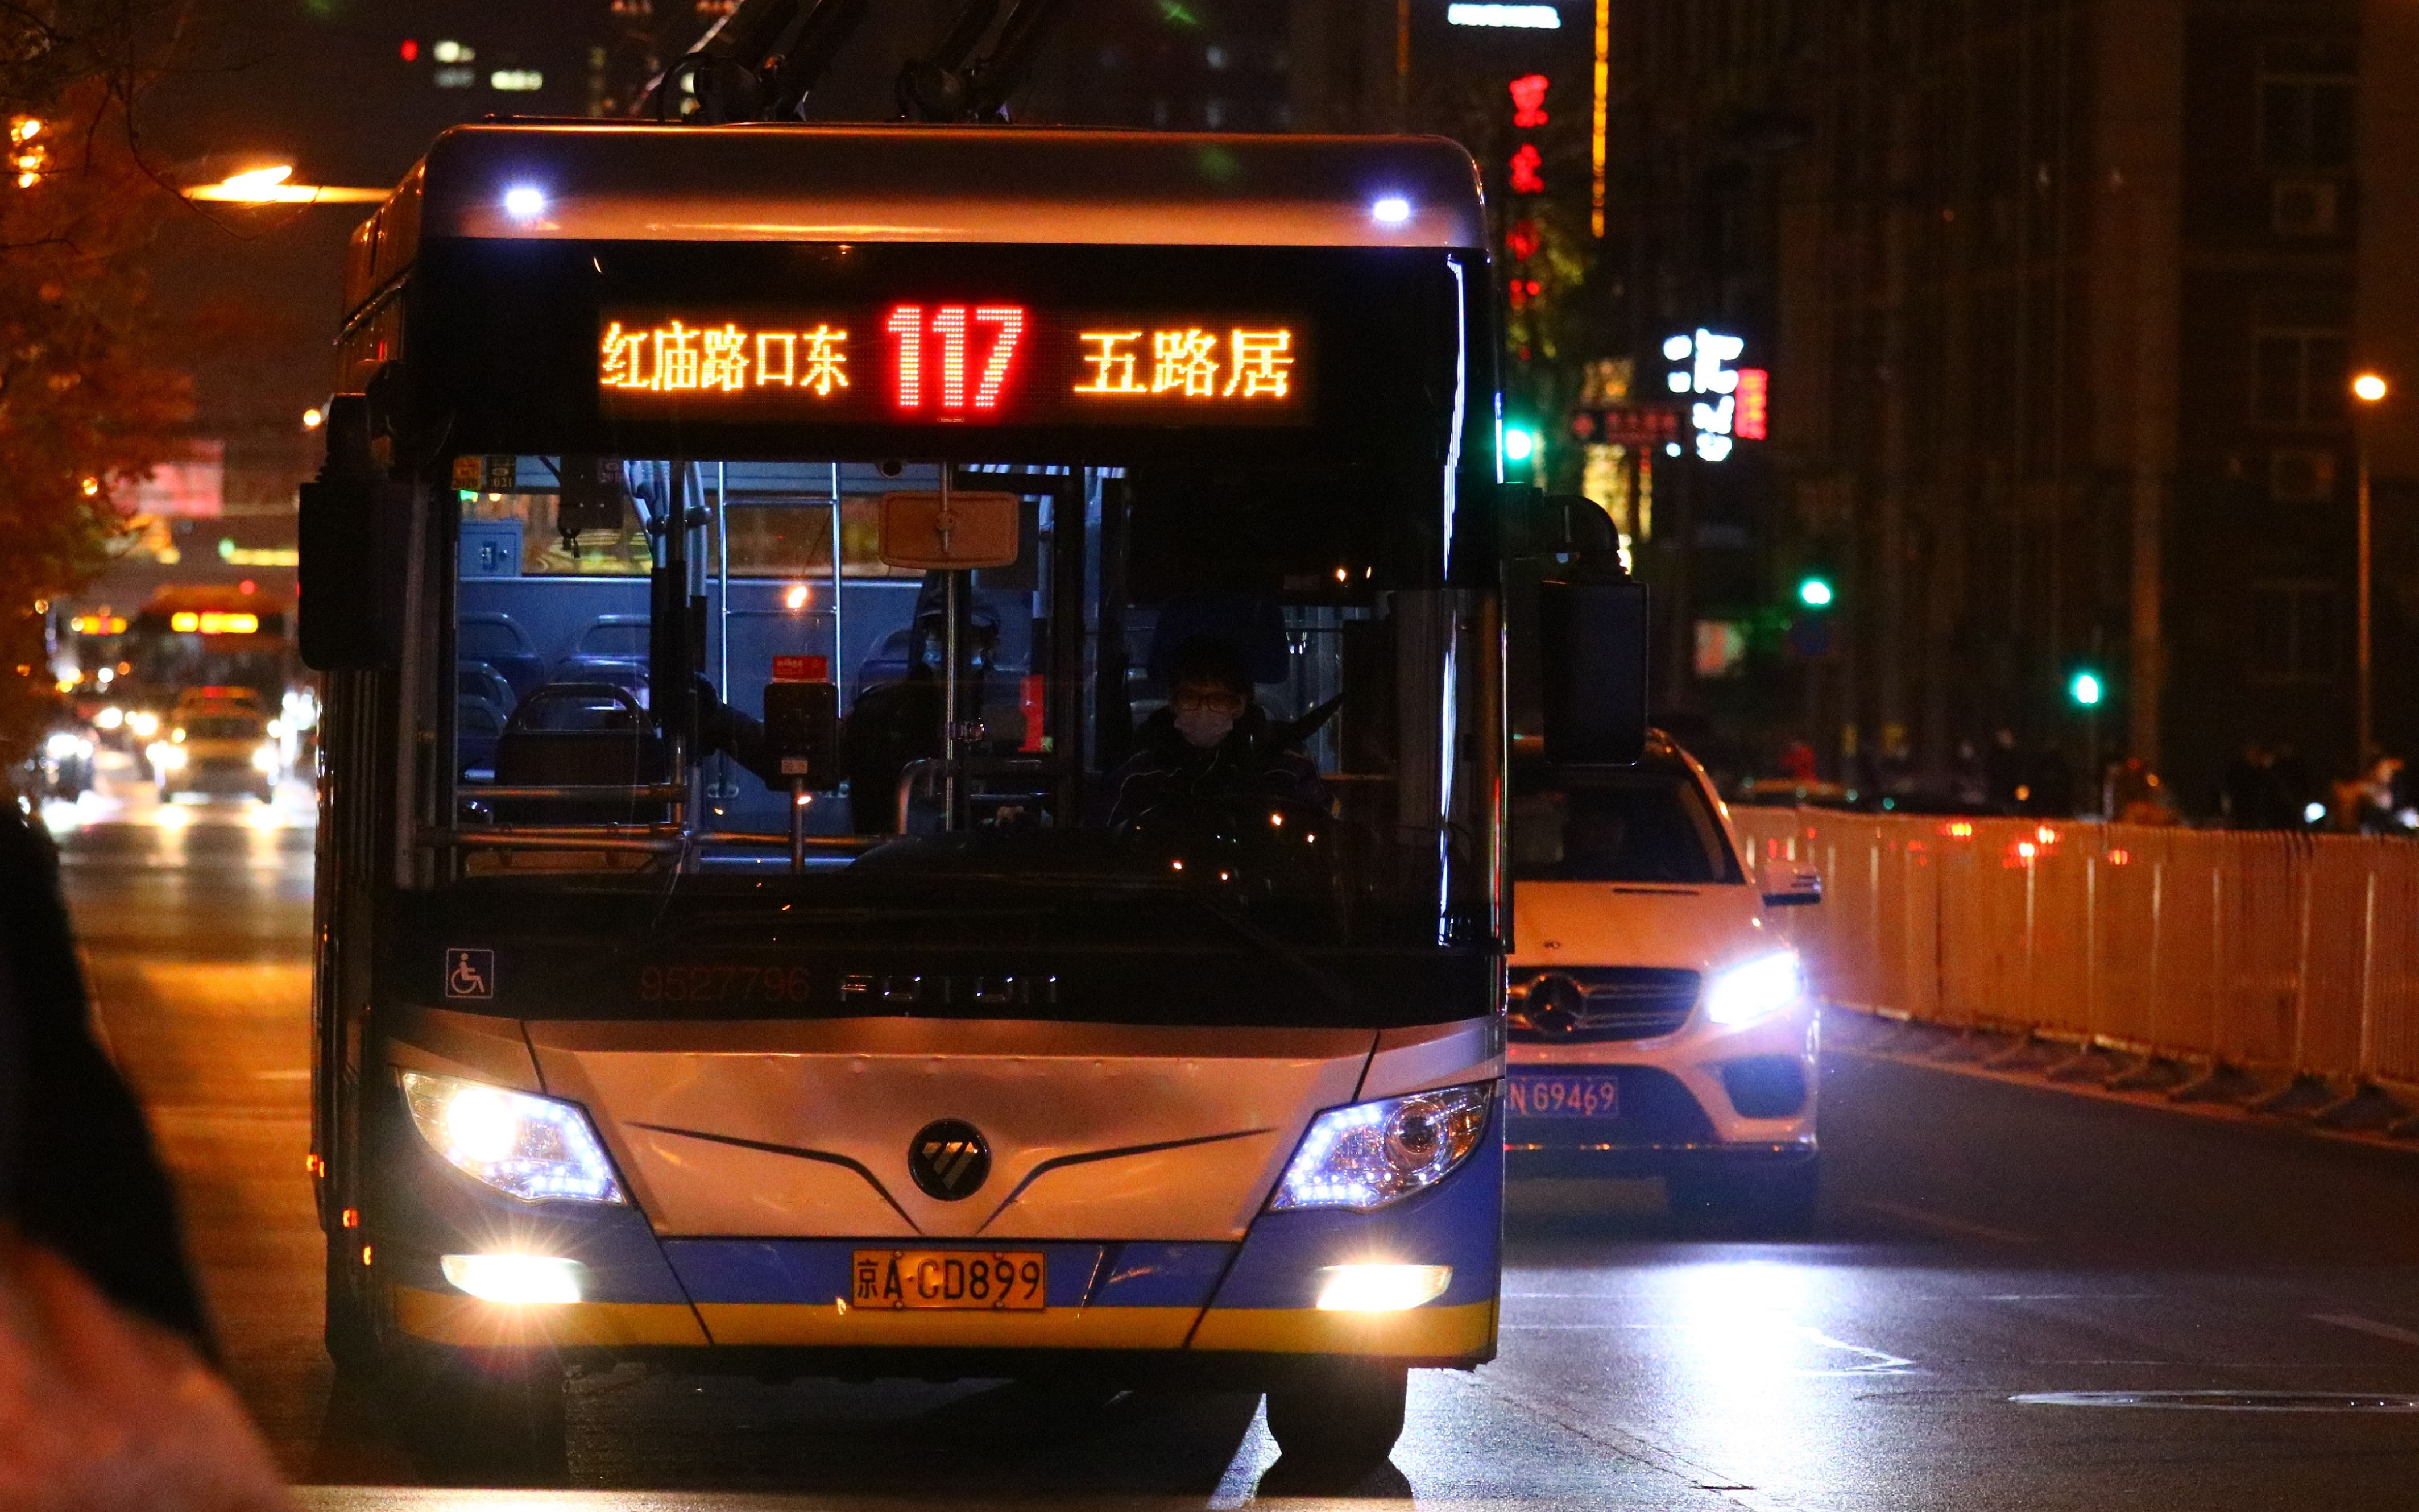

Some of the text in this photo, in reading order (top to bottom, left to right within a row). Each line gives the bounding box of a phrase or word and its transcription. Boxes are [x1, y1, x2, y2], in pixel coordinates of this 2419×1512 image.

[600, 306, 1294, 408] 红庙路口东 117 五路居
[641, 966, 810, 1002] 9527796
